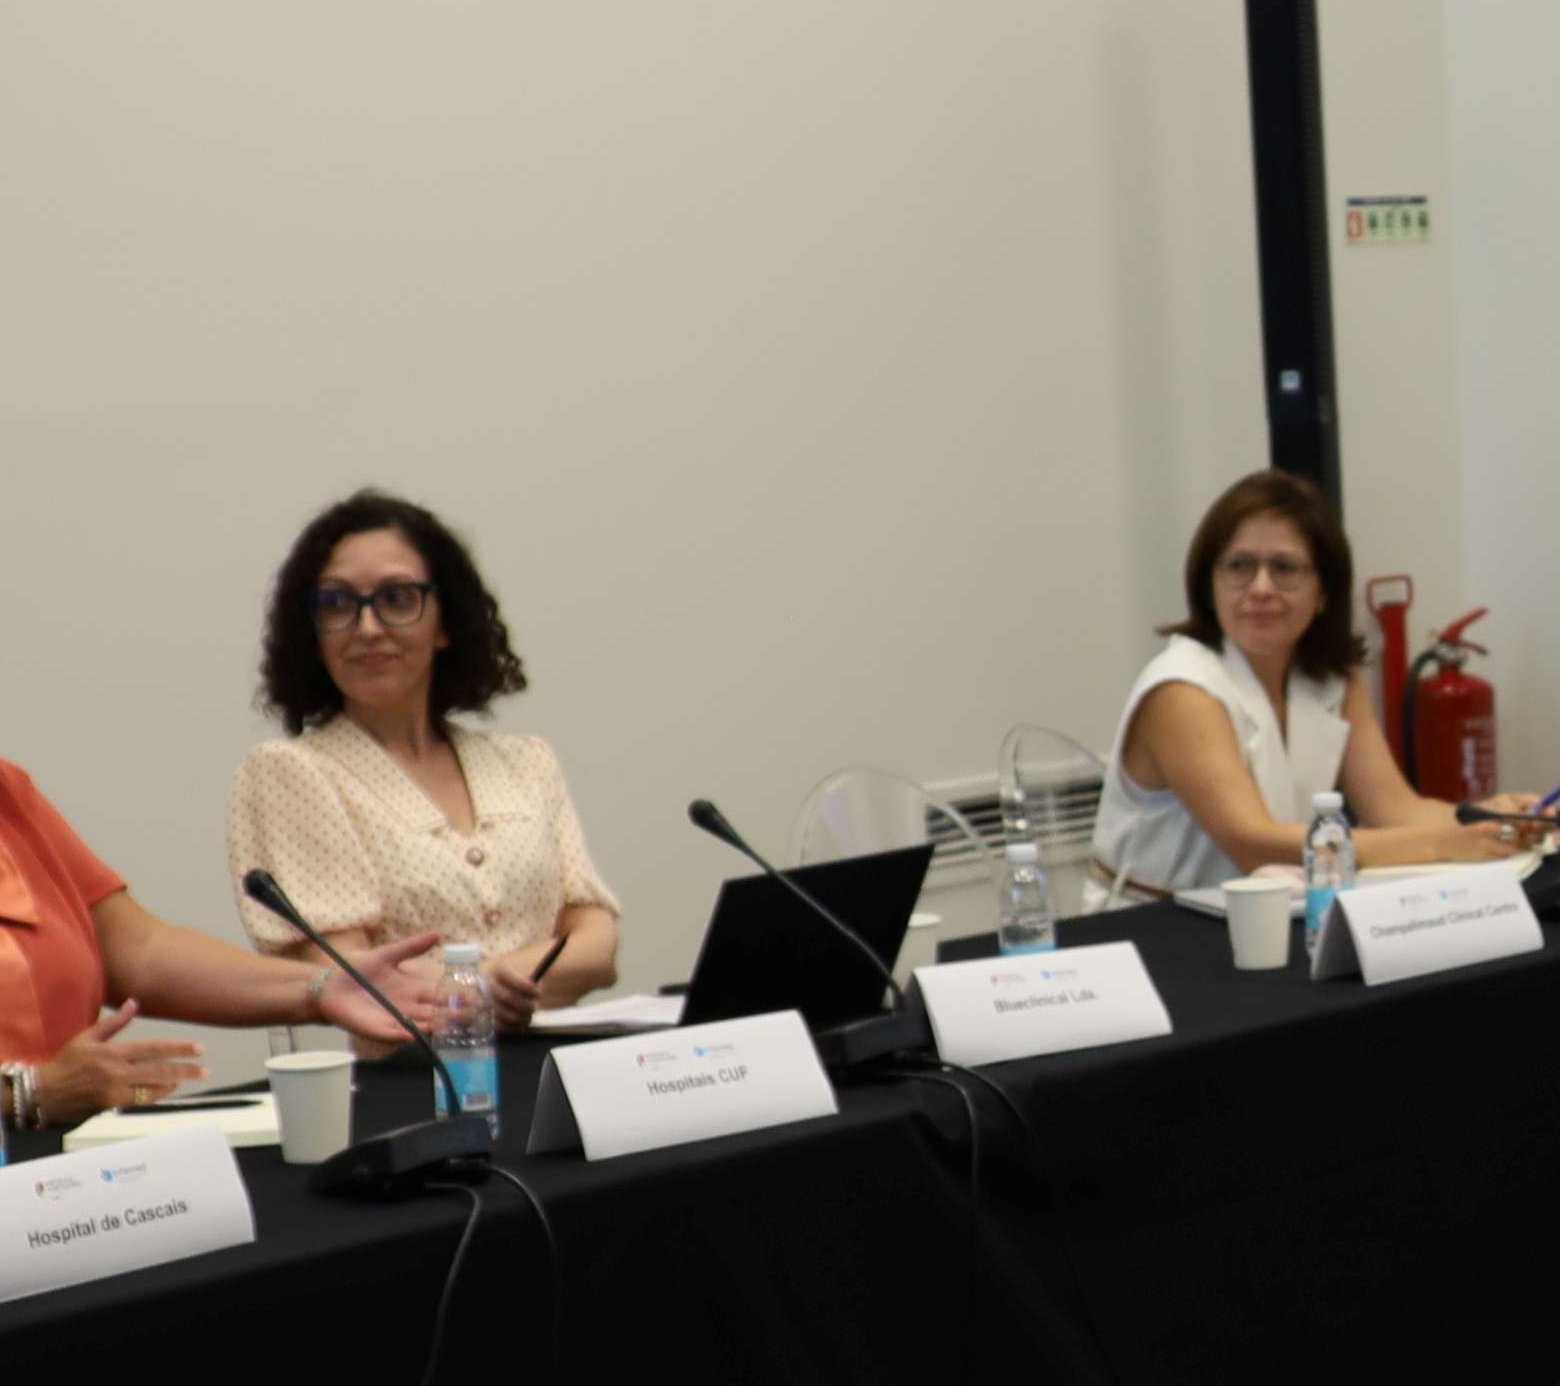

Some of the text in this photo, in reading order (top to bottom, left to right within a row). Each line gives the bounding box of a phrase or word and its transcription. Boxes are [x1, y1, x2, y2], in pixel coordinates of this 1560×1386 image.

[718, 1065, 748, 1083] CUF
[26, 1199, 188, 1248] Hospital de Cascais
